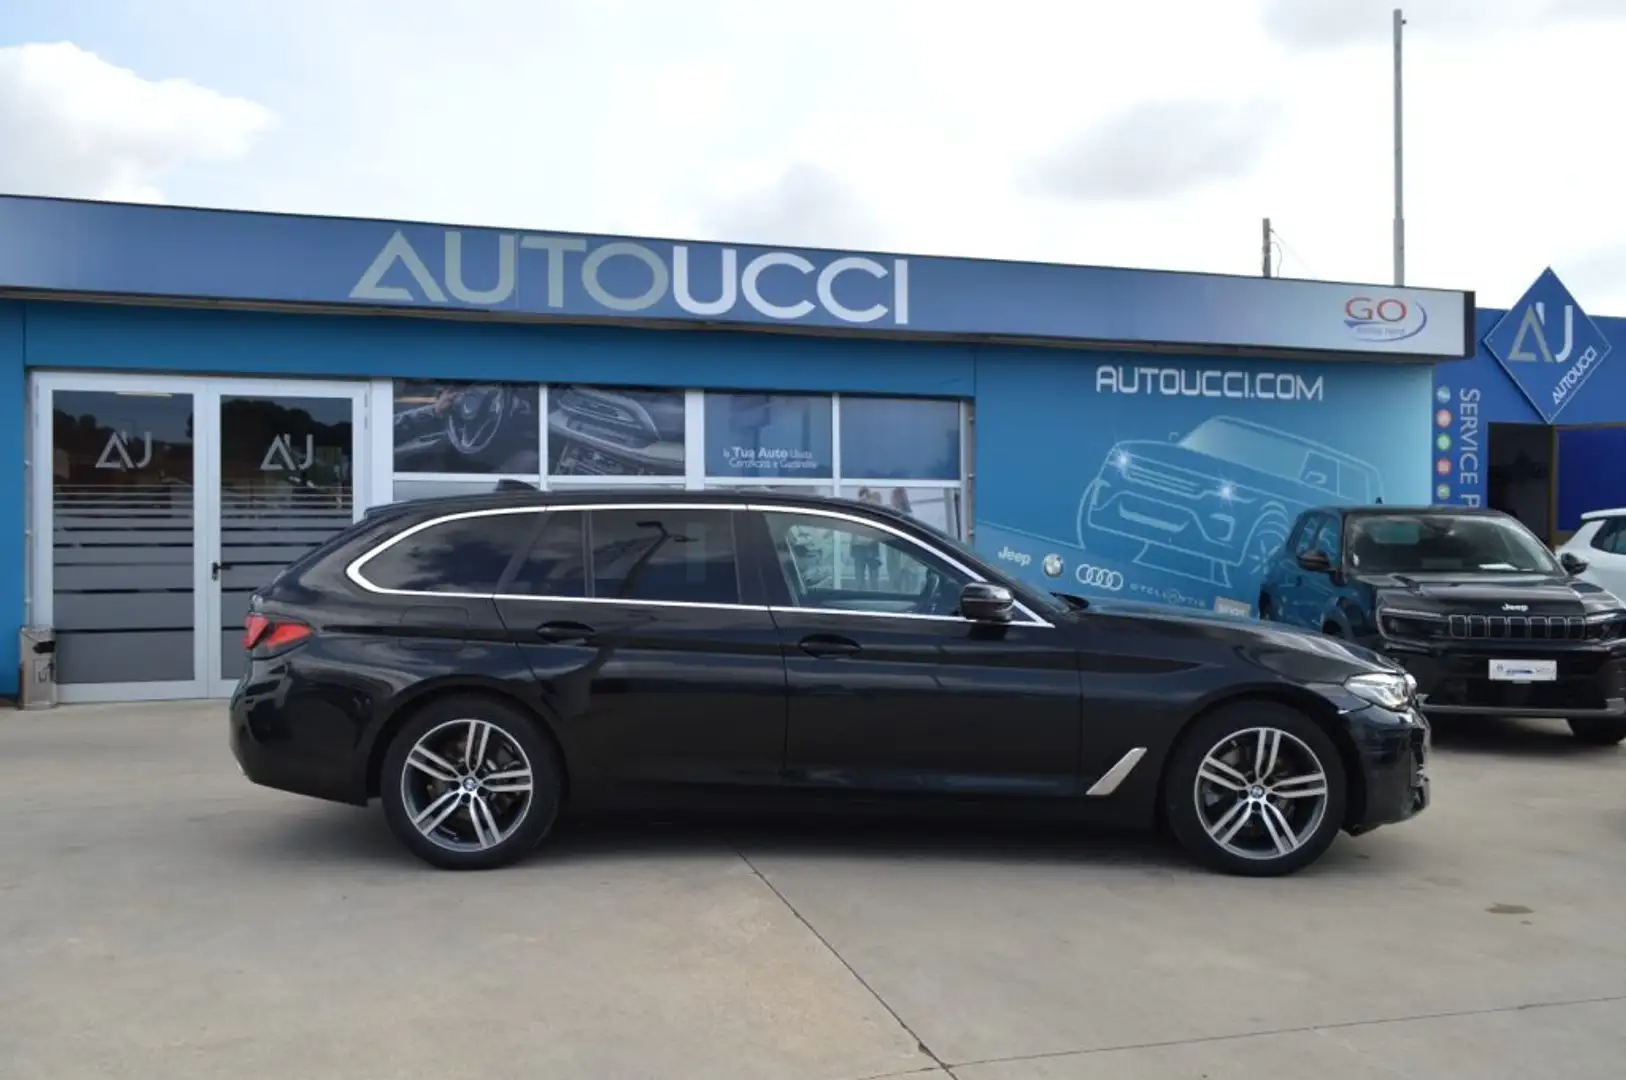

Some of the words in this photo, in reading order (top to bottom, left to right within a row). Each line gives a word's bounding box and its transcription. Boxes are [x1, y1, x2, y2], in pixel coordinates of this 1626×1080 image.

[348, 229, 910, 326] AUTOUCCI
[1345, 296, 1408, 322] GO
[1095, 365, 1324, 401] AUTOUCCI.COM
[1552, 345, 1598, 405] AUTOUCCI
[732, 446, 756, 460] Tua
[758, 447, 789, 460] Auto
[1459, 388, 1481, 485] SERVICE
[997, 546, 1031, 567] Jeep
